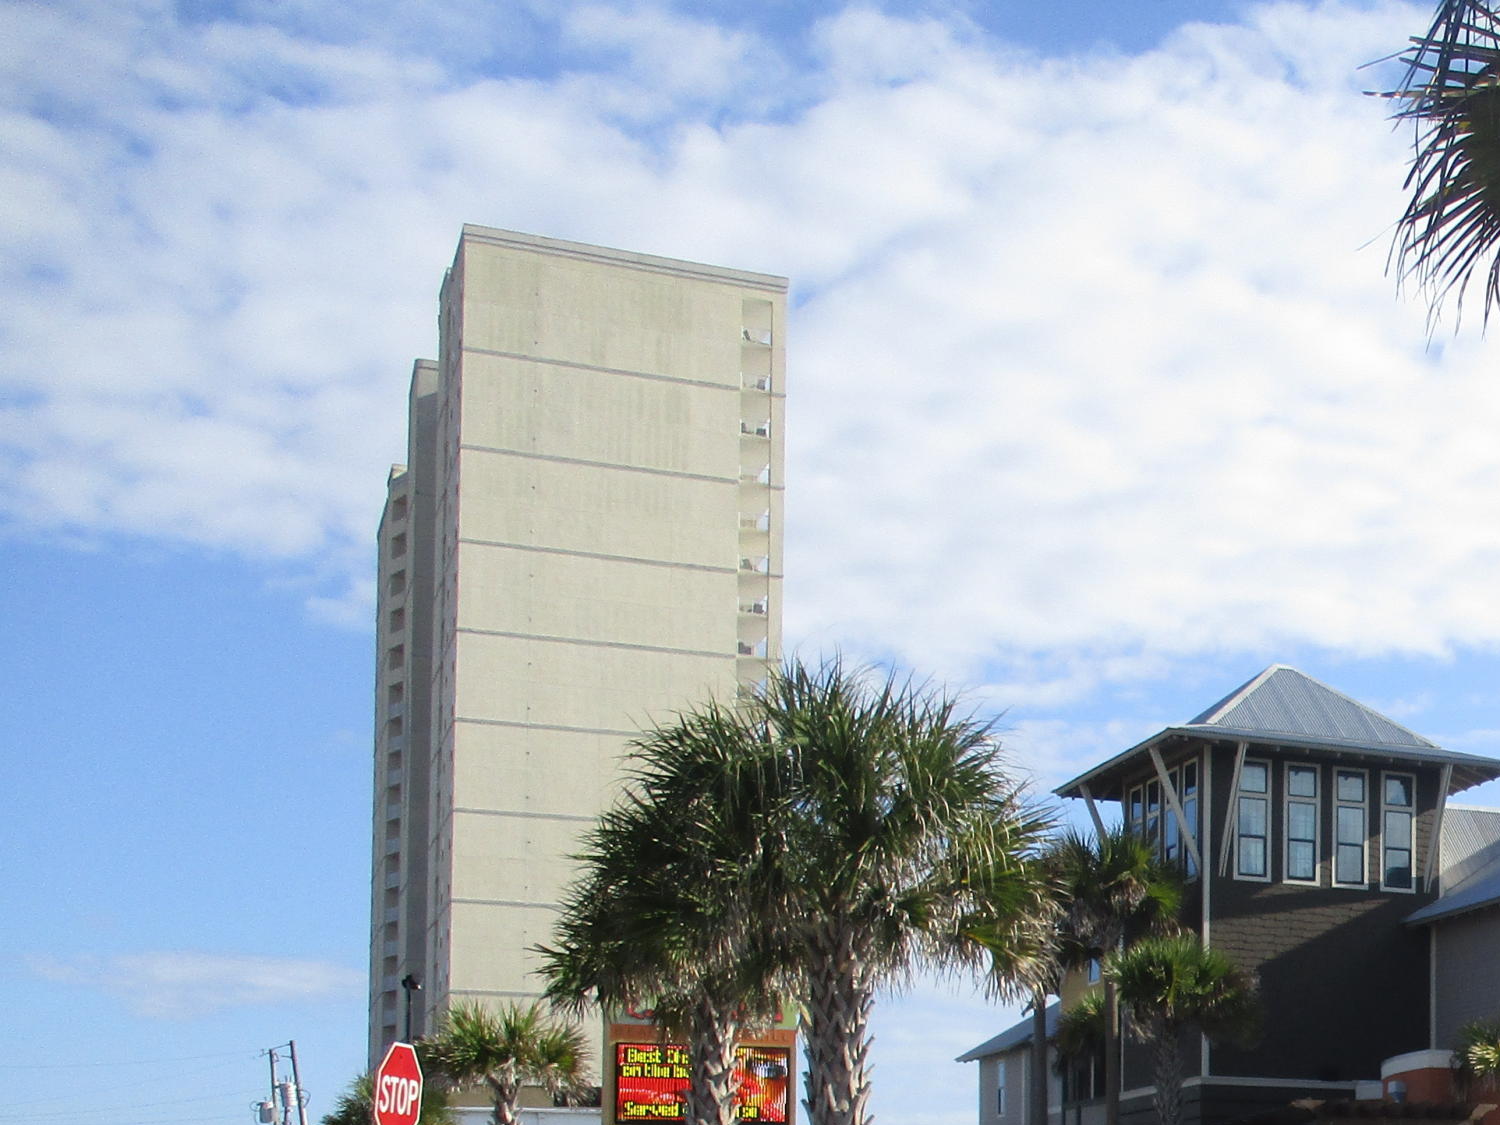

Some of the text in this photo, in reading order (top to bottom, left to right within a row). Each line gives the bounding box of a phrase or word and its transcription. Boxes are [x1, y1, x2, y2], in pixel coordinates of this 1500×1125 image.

[628, 1048, 661, 1063] Best
[379, 1075, 418, 1116] STOP
[624, 1101, 679, 1117] Served
